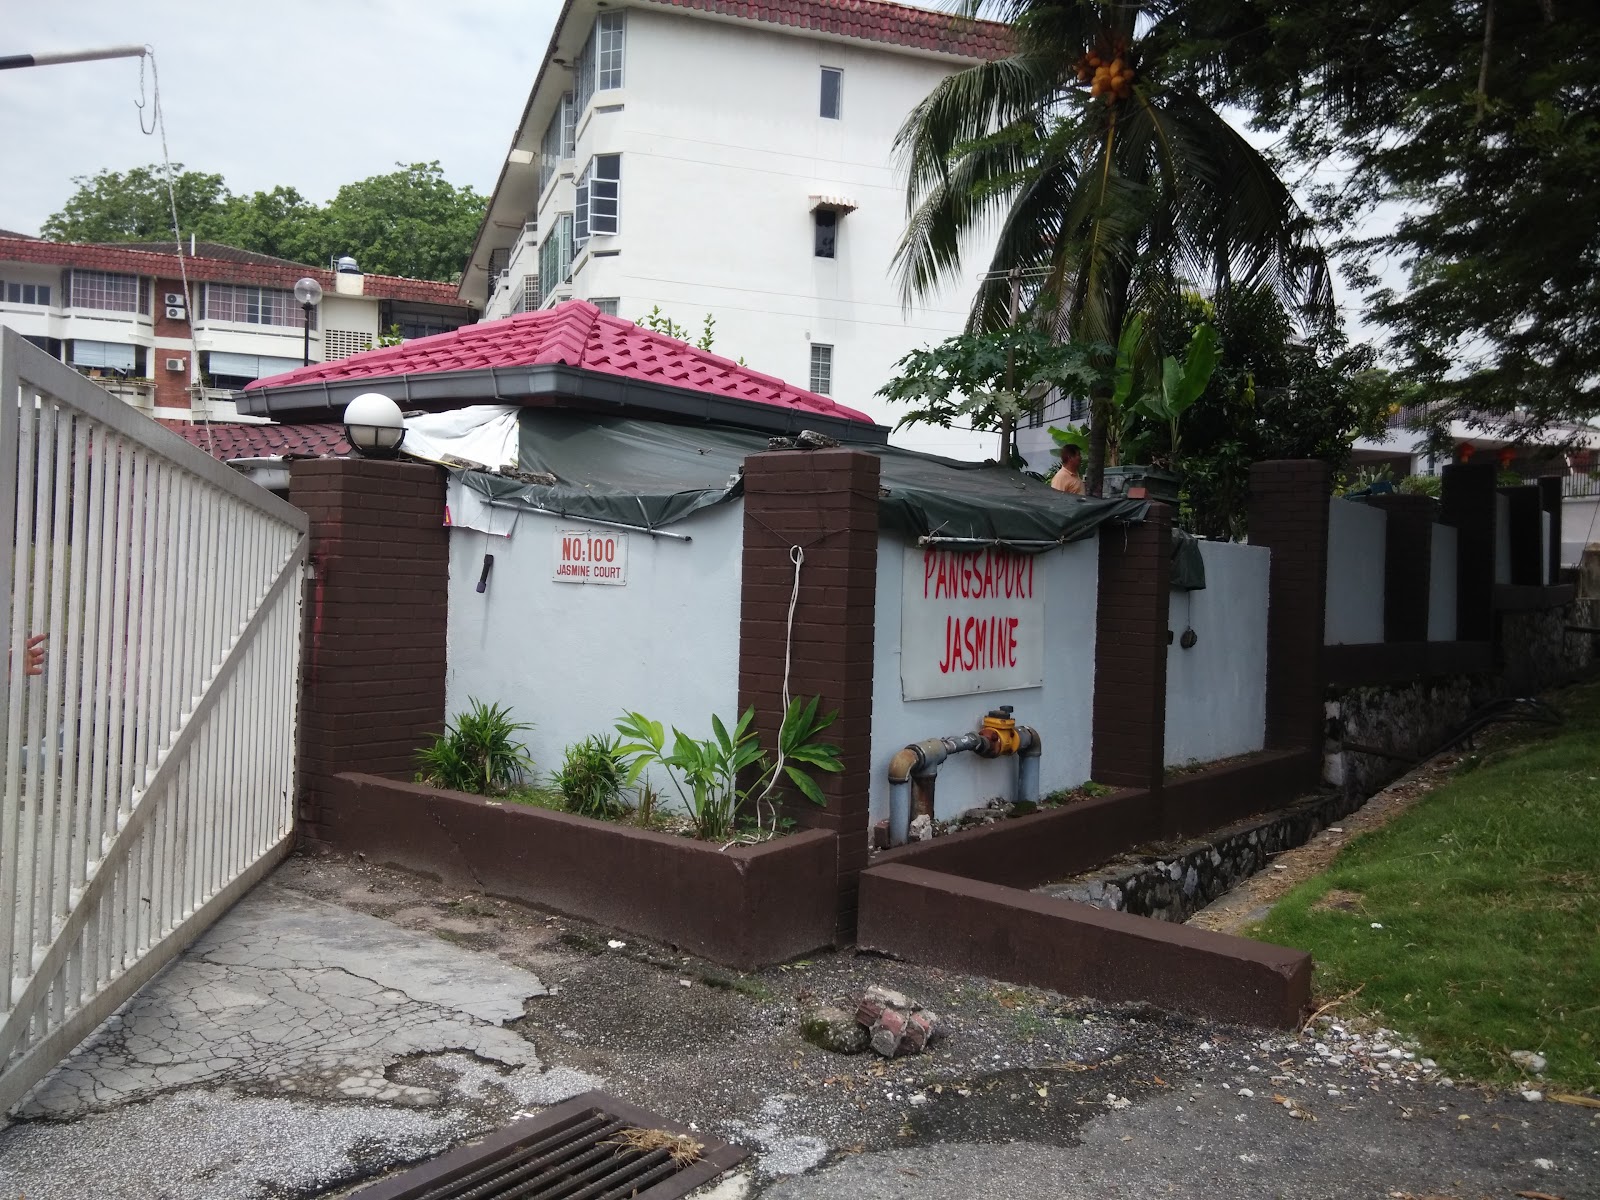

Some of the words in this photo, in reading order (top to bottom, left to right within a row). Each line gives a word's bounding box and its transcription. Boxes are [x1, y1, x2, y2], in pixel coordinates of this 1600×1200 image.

[557, 565, 590, 577] JASMINE
[594, 566, 621, 578] COURT
[924, 548, 1034, 599] PANGSAPURI
[940, 616, 1018, 673] JASMINE
